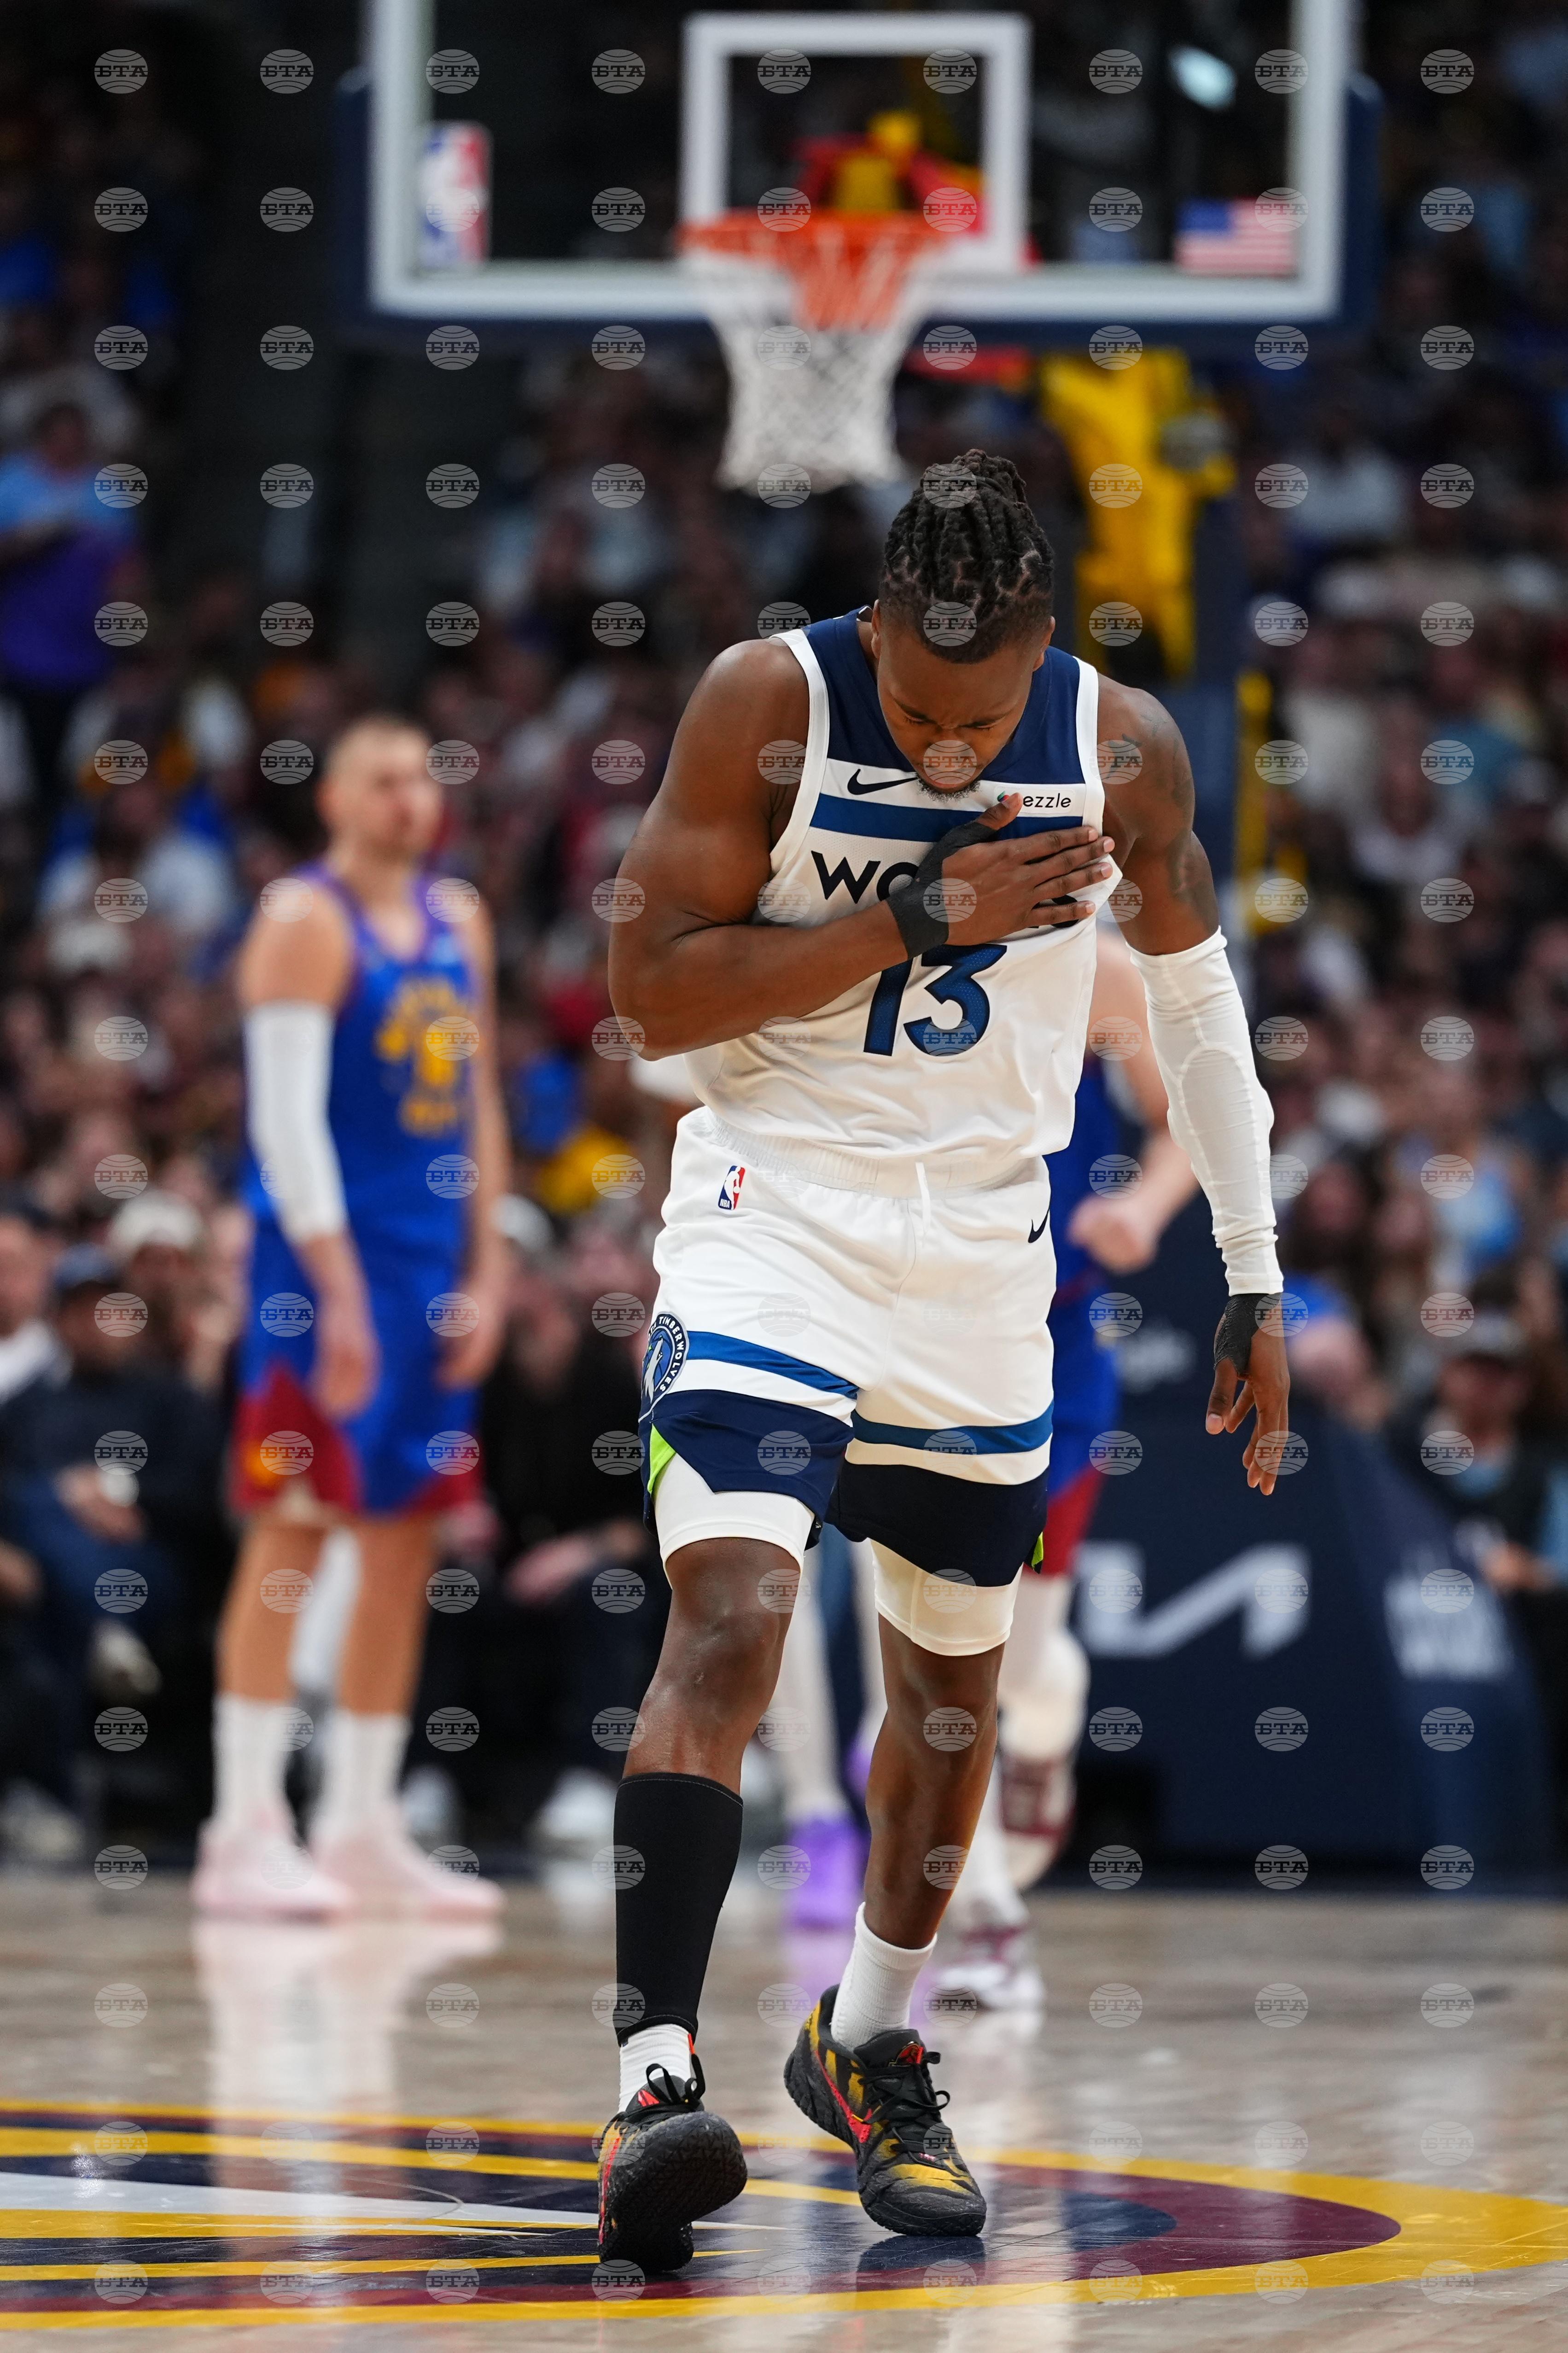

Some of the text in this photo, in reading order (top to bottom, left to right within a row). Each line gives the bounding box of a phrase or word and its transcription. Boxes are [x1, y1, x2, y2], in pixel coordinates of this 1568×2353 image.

[1023, 792, 1072, 808] ezzle
[863, 944, 1008, 1056] 13
[719, 1199, 730, 1208] NBA
[659, 1316, 684, 1392] TIMBERWOLVES
